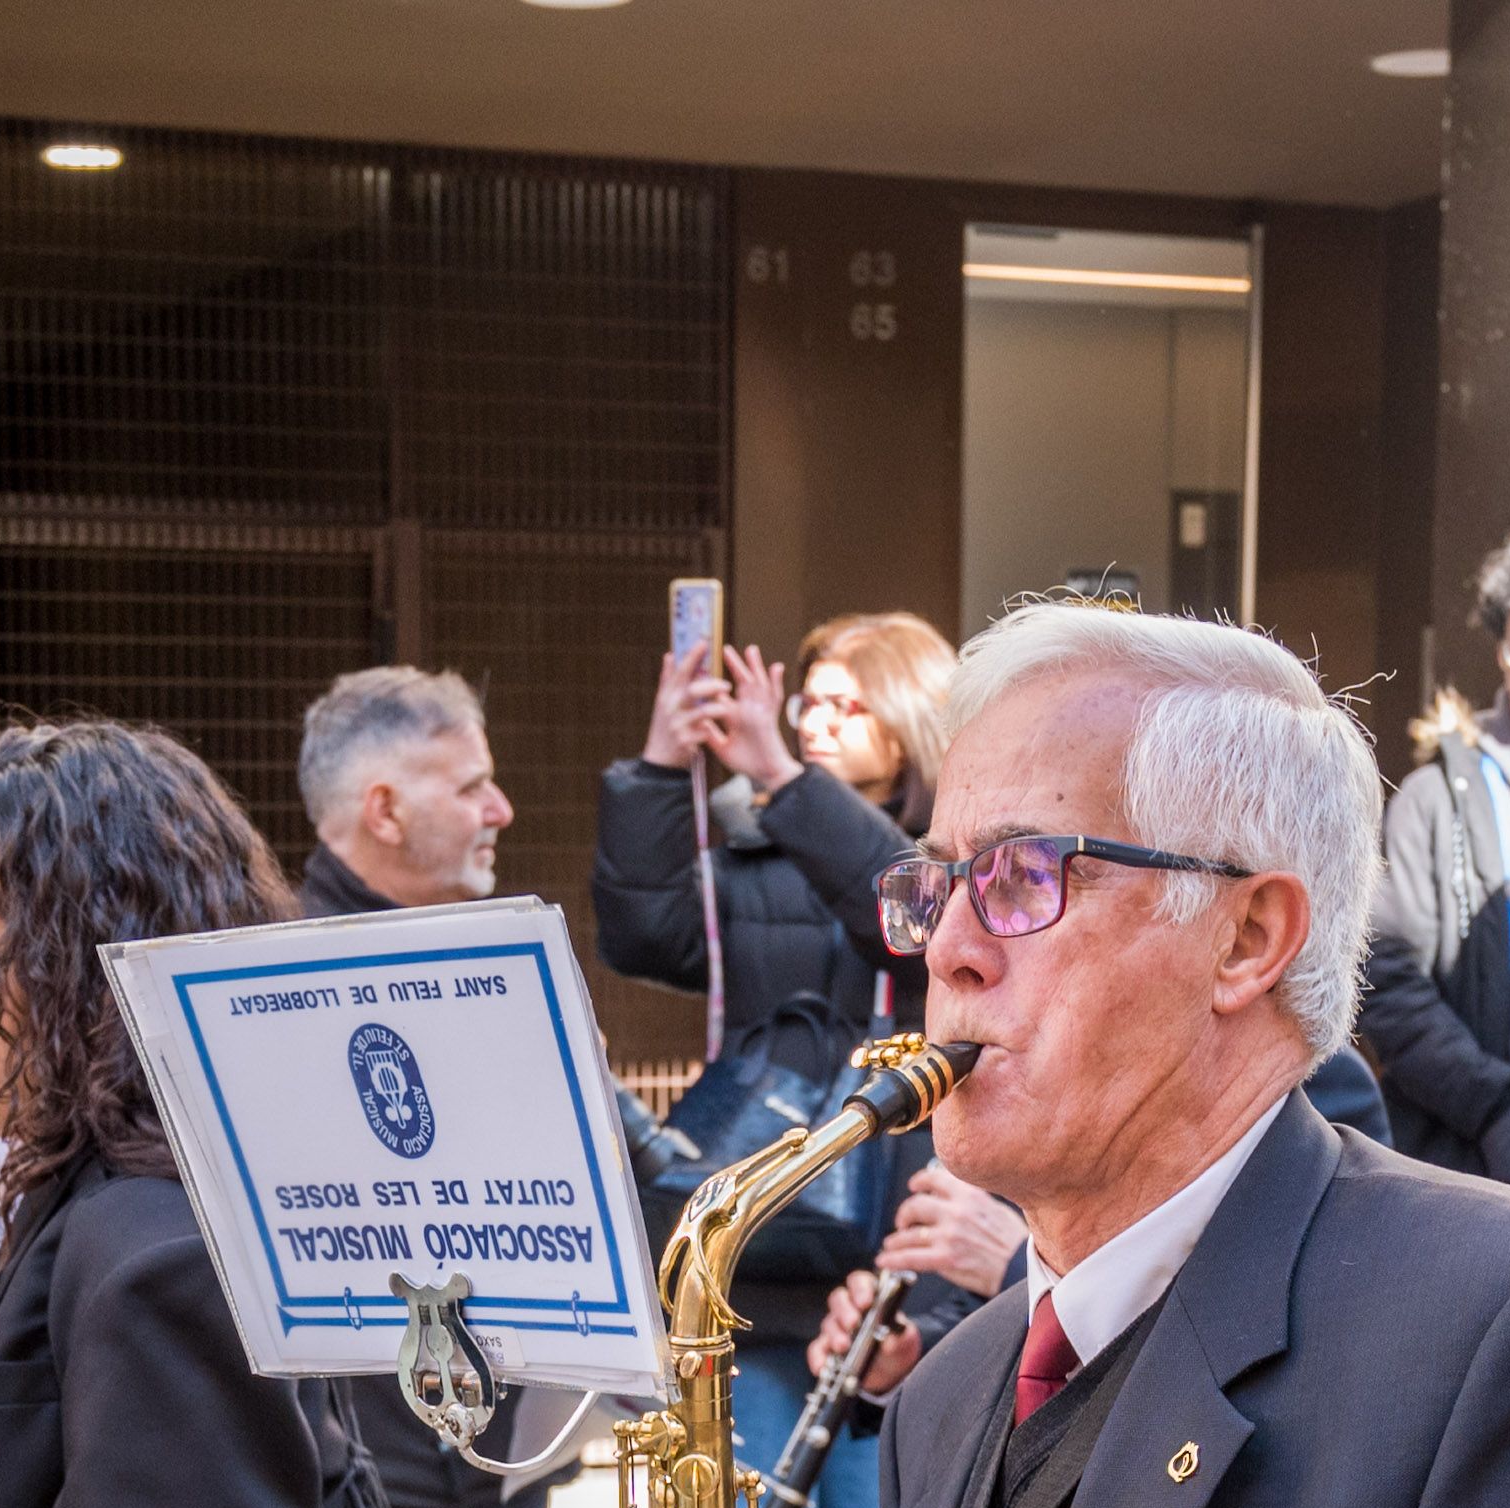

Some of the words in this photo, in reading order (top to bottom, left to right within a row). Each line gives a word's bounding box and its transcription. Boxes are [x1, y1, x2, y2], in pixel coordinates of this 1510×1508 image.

[746, 245, 789, 284] 61
[850, 303, 898, 341] 65
[349, 985, 378, 1004] DE
[388, 979, 442, 1002] FELIU
[455, 975, 507, 997] SANT
[230, 989, 340, 1016] LLOBREGAT
[364, 1028, 393, 1047] FELIU
[362, 1089, 398, 1148] MUSICAL
[402, 1084, 432, 1154] ASSOCIACIÓ
[275, 1183, 361, 1210] ROSES
[373, 1180, 421, 1206] LES
[432, 1180, 469, 1205] DE
[484, 1179, 575, 1206] CIUTAT
[279, 1224, 413, 1263] MUSICAL
[424, 1224, 593, 1269] ASSOCIACIÓ
